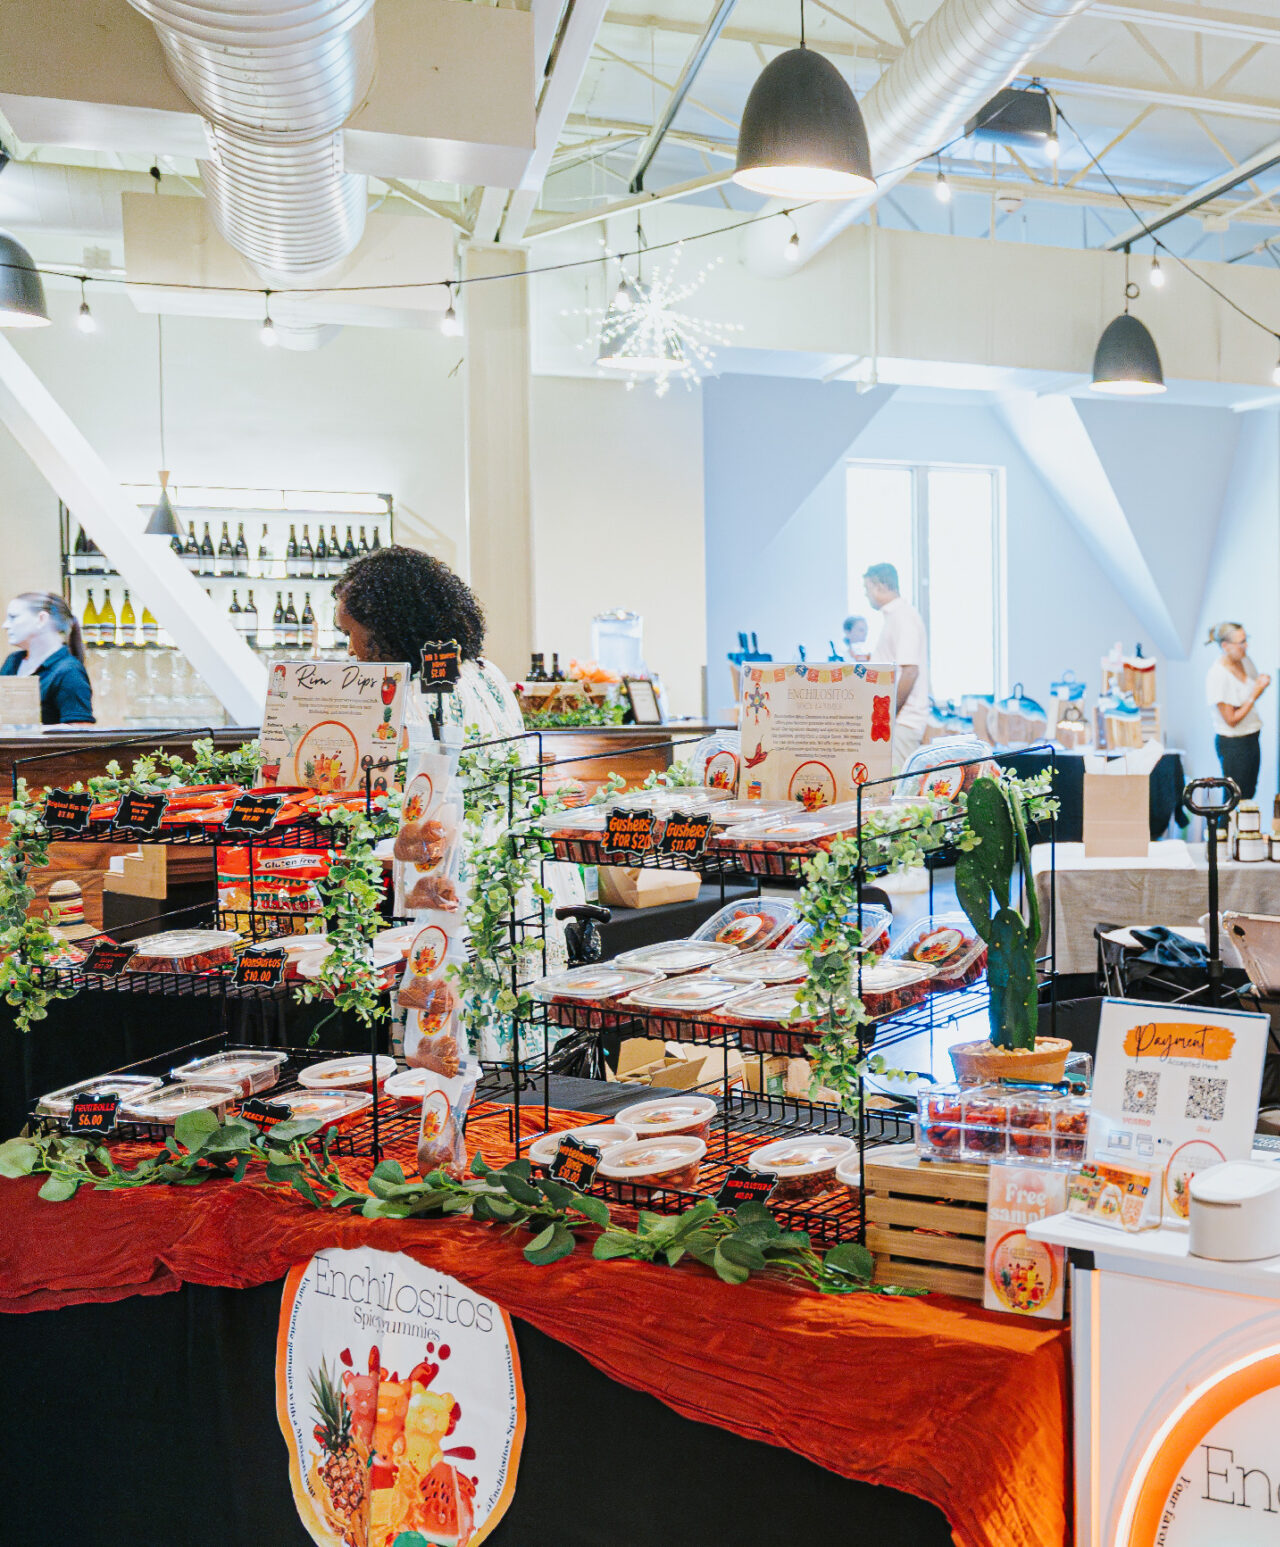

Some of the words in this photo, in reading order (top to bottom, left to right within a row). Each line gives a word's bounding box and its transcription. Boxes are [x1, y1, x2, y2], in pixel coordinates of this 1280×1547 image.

[295, 664, 332, 689] Rim
[341, 665, 378, 694] Dips
[602, 832, 610, 847] 2
[631, 833, 651, 849] $20
[670, 839, 697, 851] $11.00
[243, 970, 271, 982] $10.00
[1135, 1022, 1214, 1063] Payment
[78, 1114, 103, 1126] $6.00
[1005, 1182, 1048, 1207] Free
[989, 1206, 1046, 1224] sampl
[298, 1277, 311, 1299] Your
[314, 1256, 494, 1333] Enchilositos
[289, 1300, 302, 1340] favorite
[1169, 1476, 1192, 1506] Your
